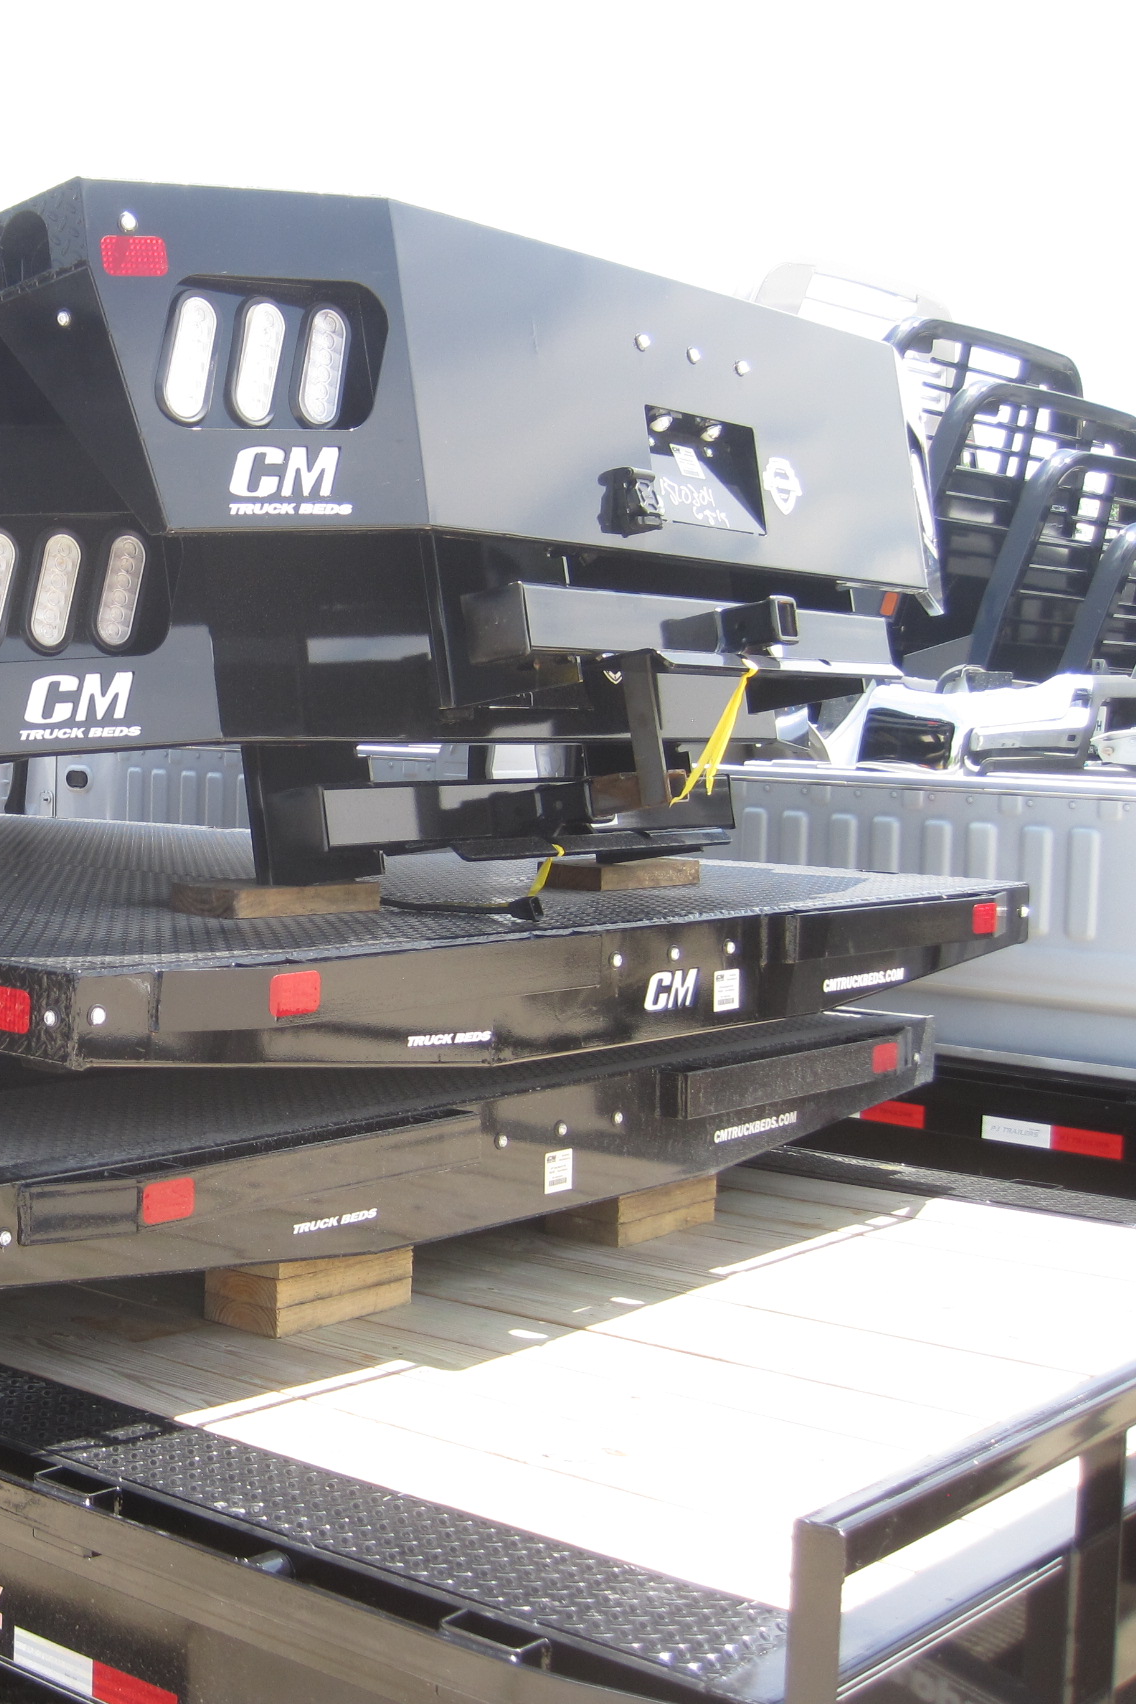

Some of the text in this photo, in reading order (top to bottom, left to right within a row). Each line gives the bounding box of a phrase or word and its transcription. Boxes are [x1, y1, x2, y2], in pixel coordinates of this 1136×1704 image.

[229, 445, 340, 497] CM
[229, 503, 353, 515] TRUCK BEDS
[24, 671, 134, 724] CM
[19, 726, 142, 741] TRUCK BEDS
[644, 968, 698, 1013] CM
[823, 967, 905, 993] CMTRUCKBEDS.COM
[407, 1030, 492, 1047] TRUCK BEDS
[713, 1111, 798, 1144] CMTRUCKBEDS.COM
[292, 1208, 378, 1235] TRUCK BEDS
